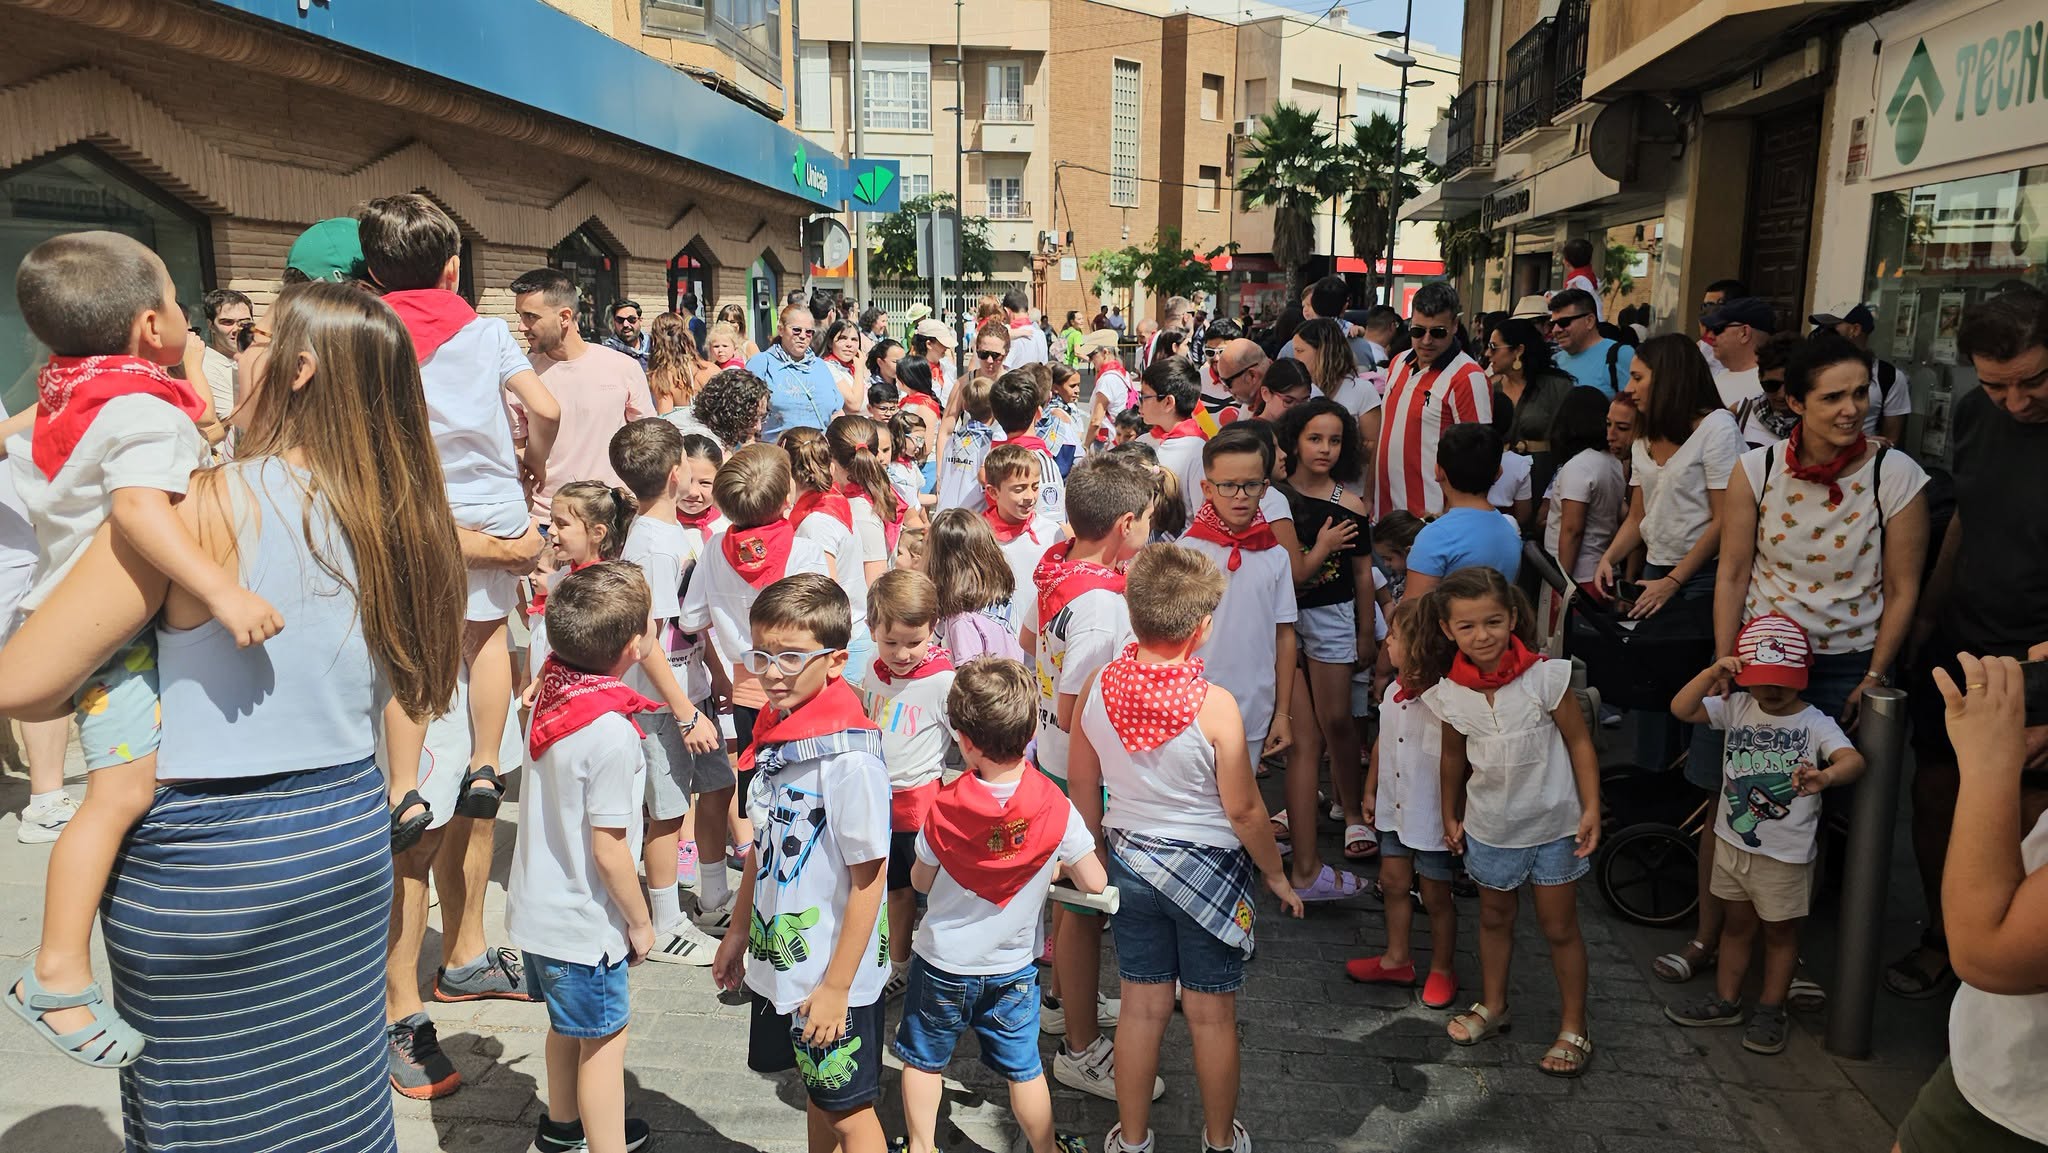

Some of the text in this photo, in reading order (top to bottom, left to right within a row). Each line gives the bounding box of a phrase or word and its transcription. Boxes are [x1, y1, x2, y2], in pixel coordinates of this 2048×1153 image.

[1955, 20, 2048, 122] TECN
[806, 162, 828, 198] Unicaja
[1731, 750, 1803, 774] MODE
